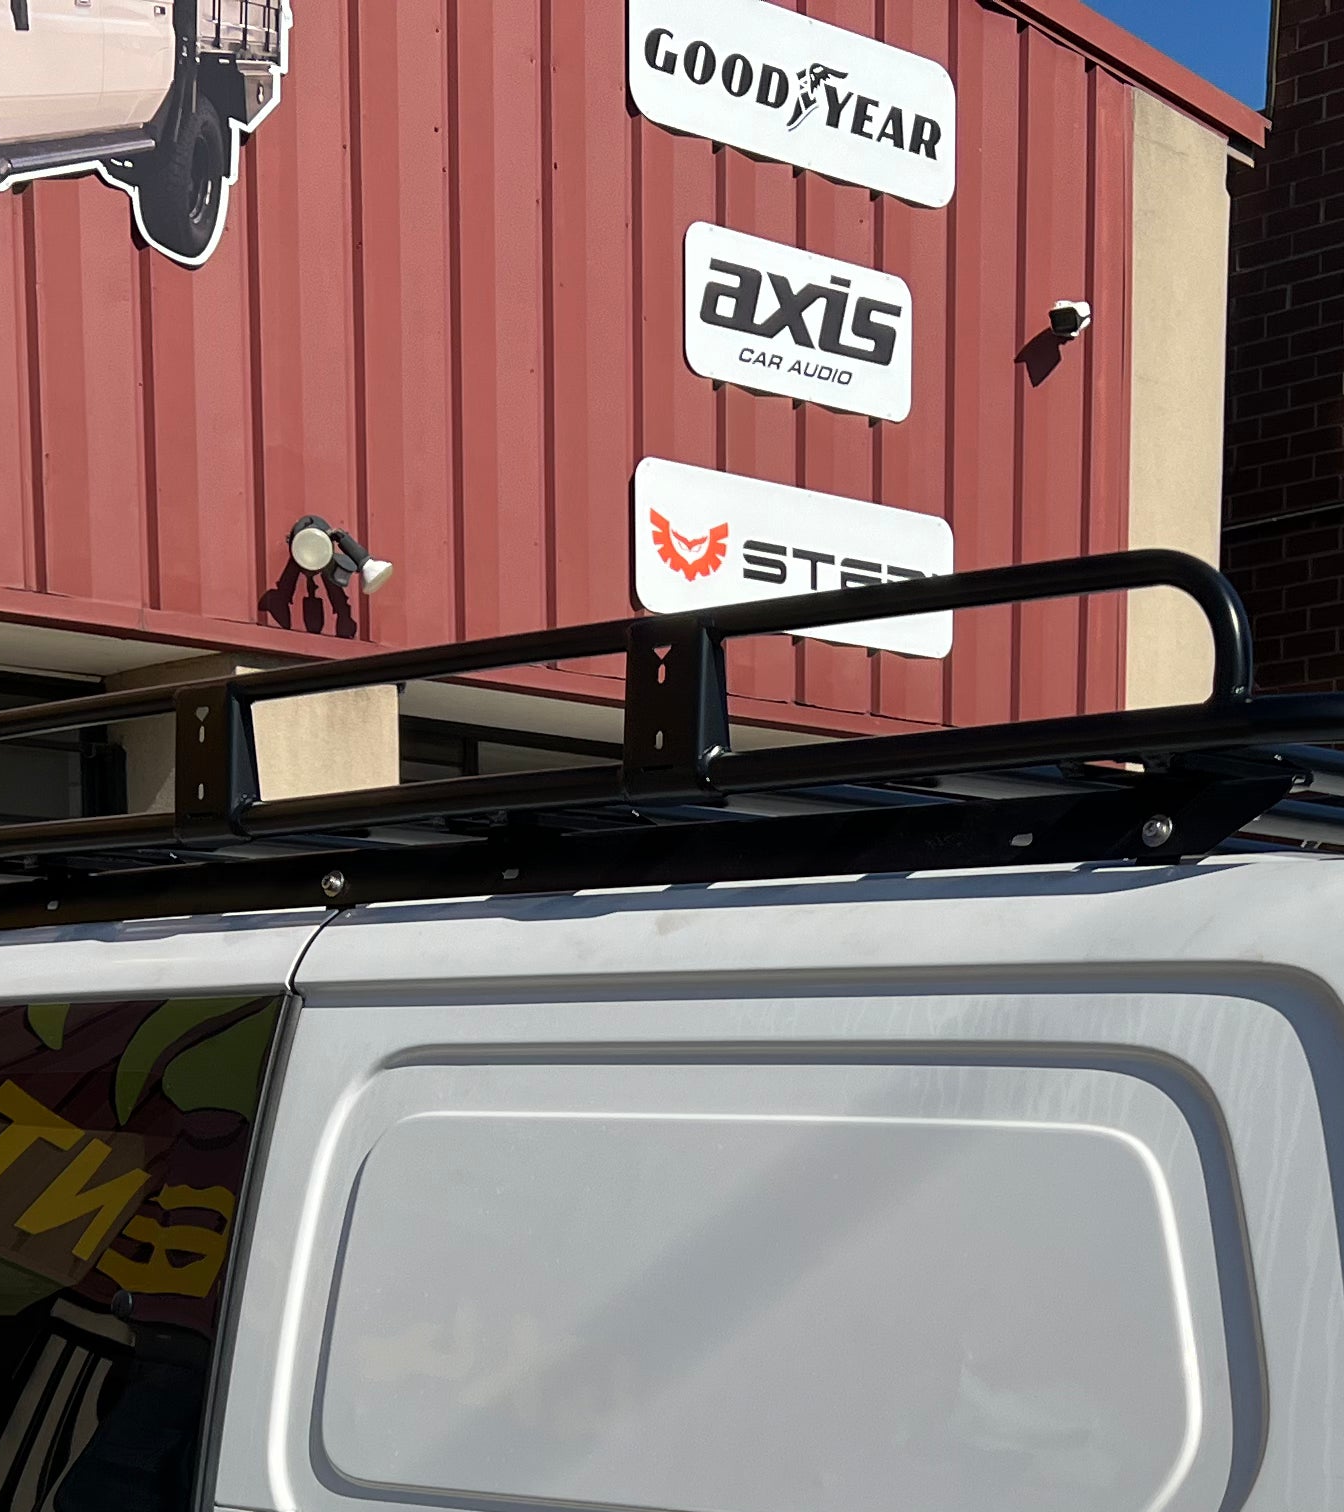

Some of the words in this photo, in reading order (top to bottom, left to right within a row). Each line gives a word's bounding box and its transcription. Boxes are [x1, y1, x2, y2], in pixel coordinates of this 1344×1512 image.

[738, 347, 783, 371] CAR
[788, 359, 852, 387] AUDIO
[743, 540, 940, 590] STE
